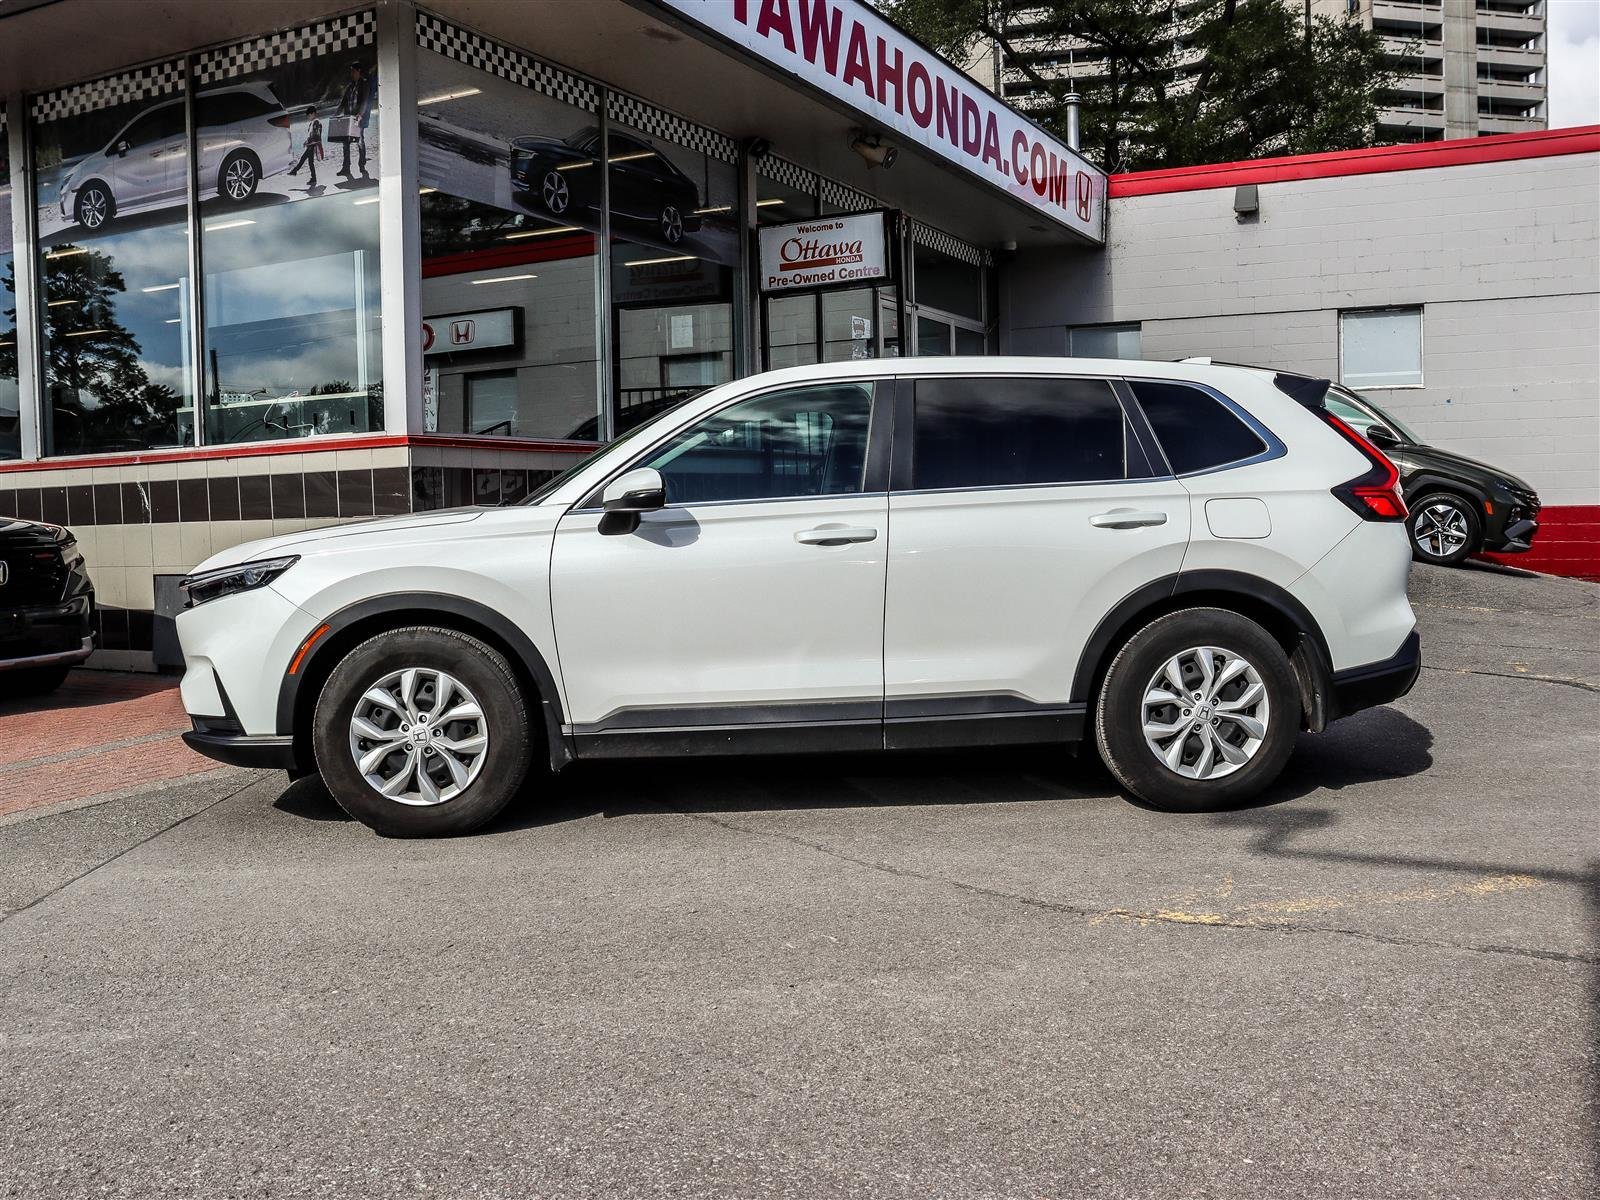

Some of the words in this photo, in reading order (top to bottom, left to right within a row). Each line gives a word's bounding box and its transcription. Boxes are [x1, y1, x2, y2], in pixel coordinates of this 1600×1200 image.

[733, 0, 1067, 210] AWAHONDA.COM
[797, 223, 834, 234] Welcome
[835, 221, 844, 230] to
[780, 237, 863, 262] Ottawa
[836, 256, 861, 264] HONDA
[768, 269, 835, 287] Pre-Owned
[839, 265, 880, 279] Centre
